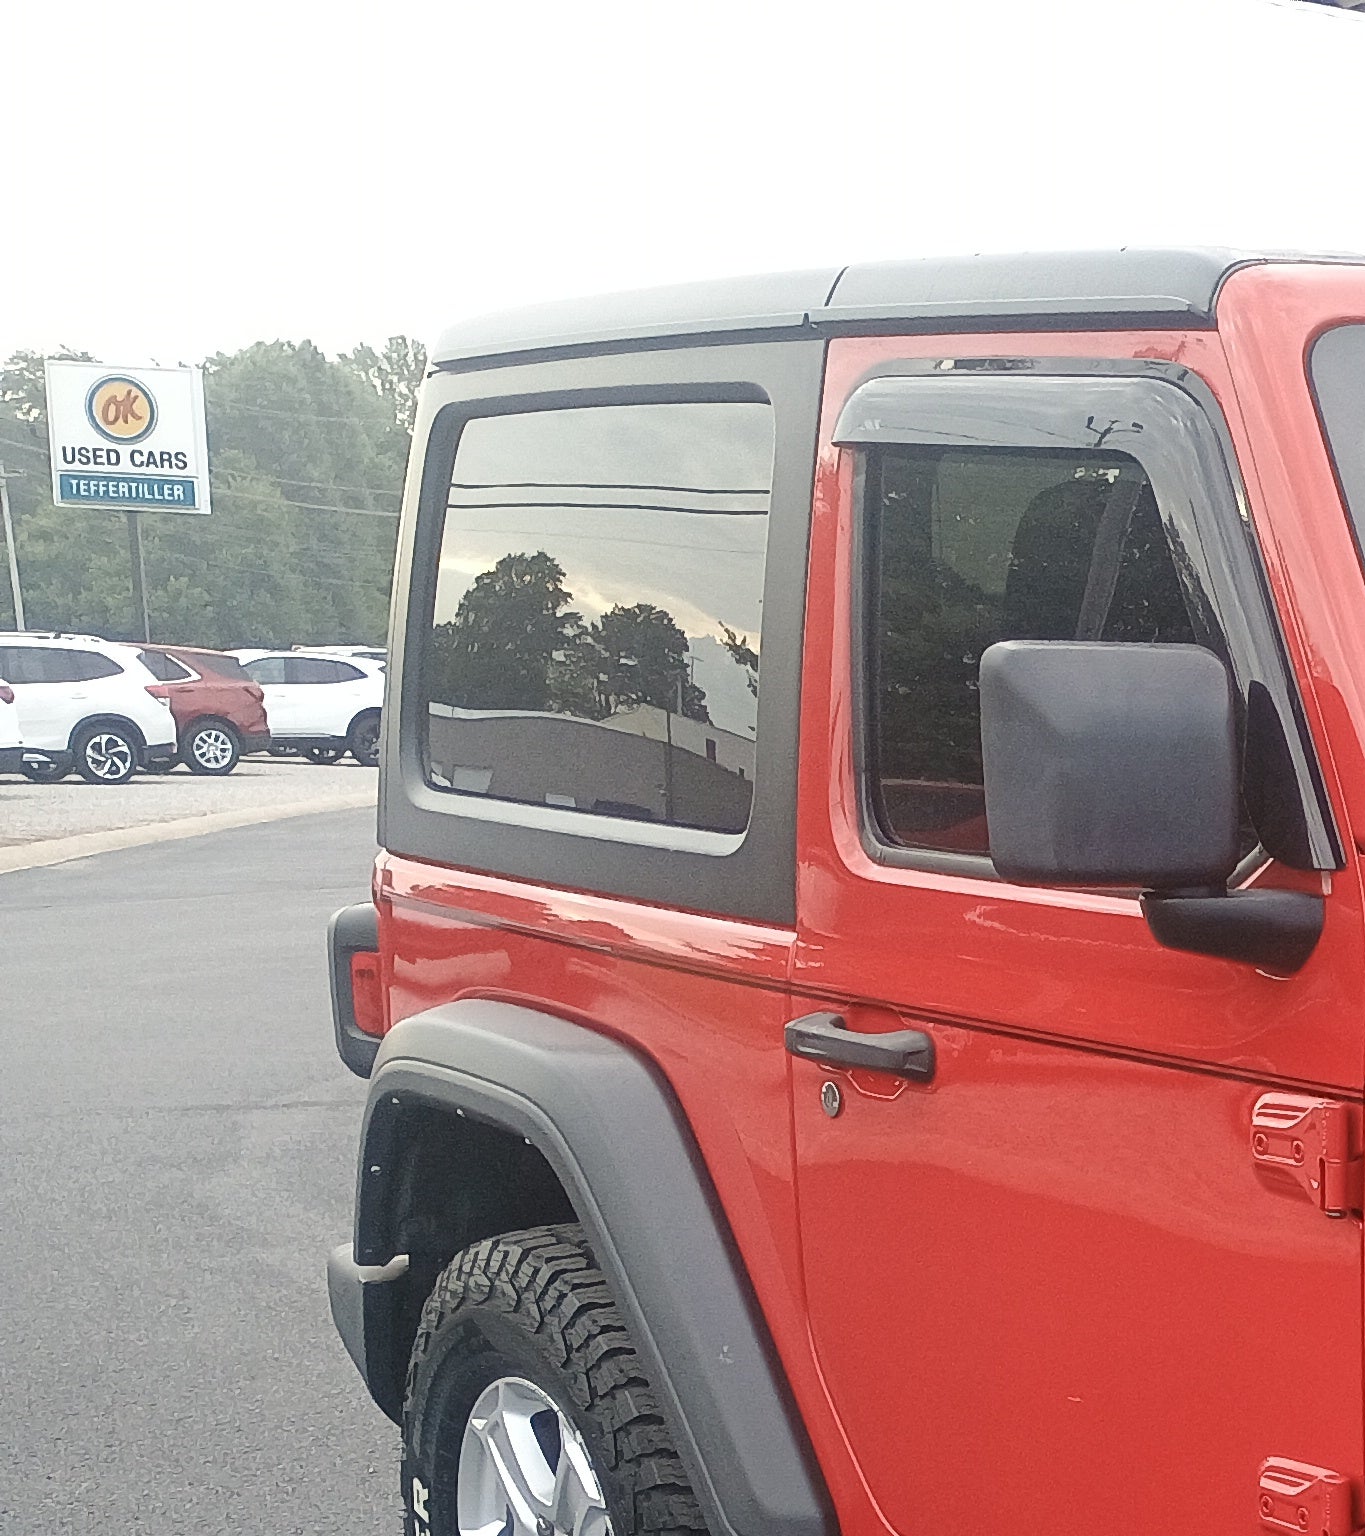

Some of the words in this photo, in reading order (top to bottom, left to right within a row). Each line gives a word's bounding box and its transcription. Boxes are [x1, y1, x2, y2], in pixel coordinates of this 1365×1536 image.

[102, 389, 142, 425] OK
[62, 446, 120, 466] USED
[130, 449, 187, 470] CARS
[71, 480, 184, 500] TEFFERTILLER
